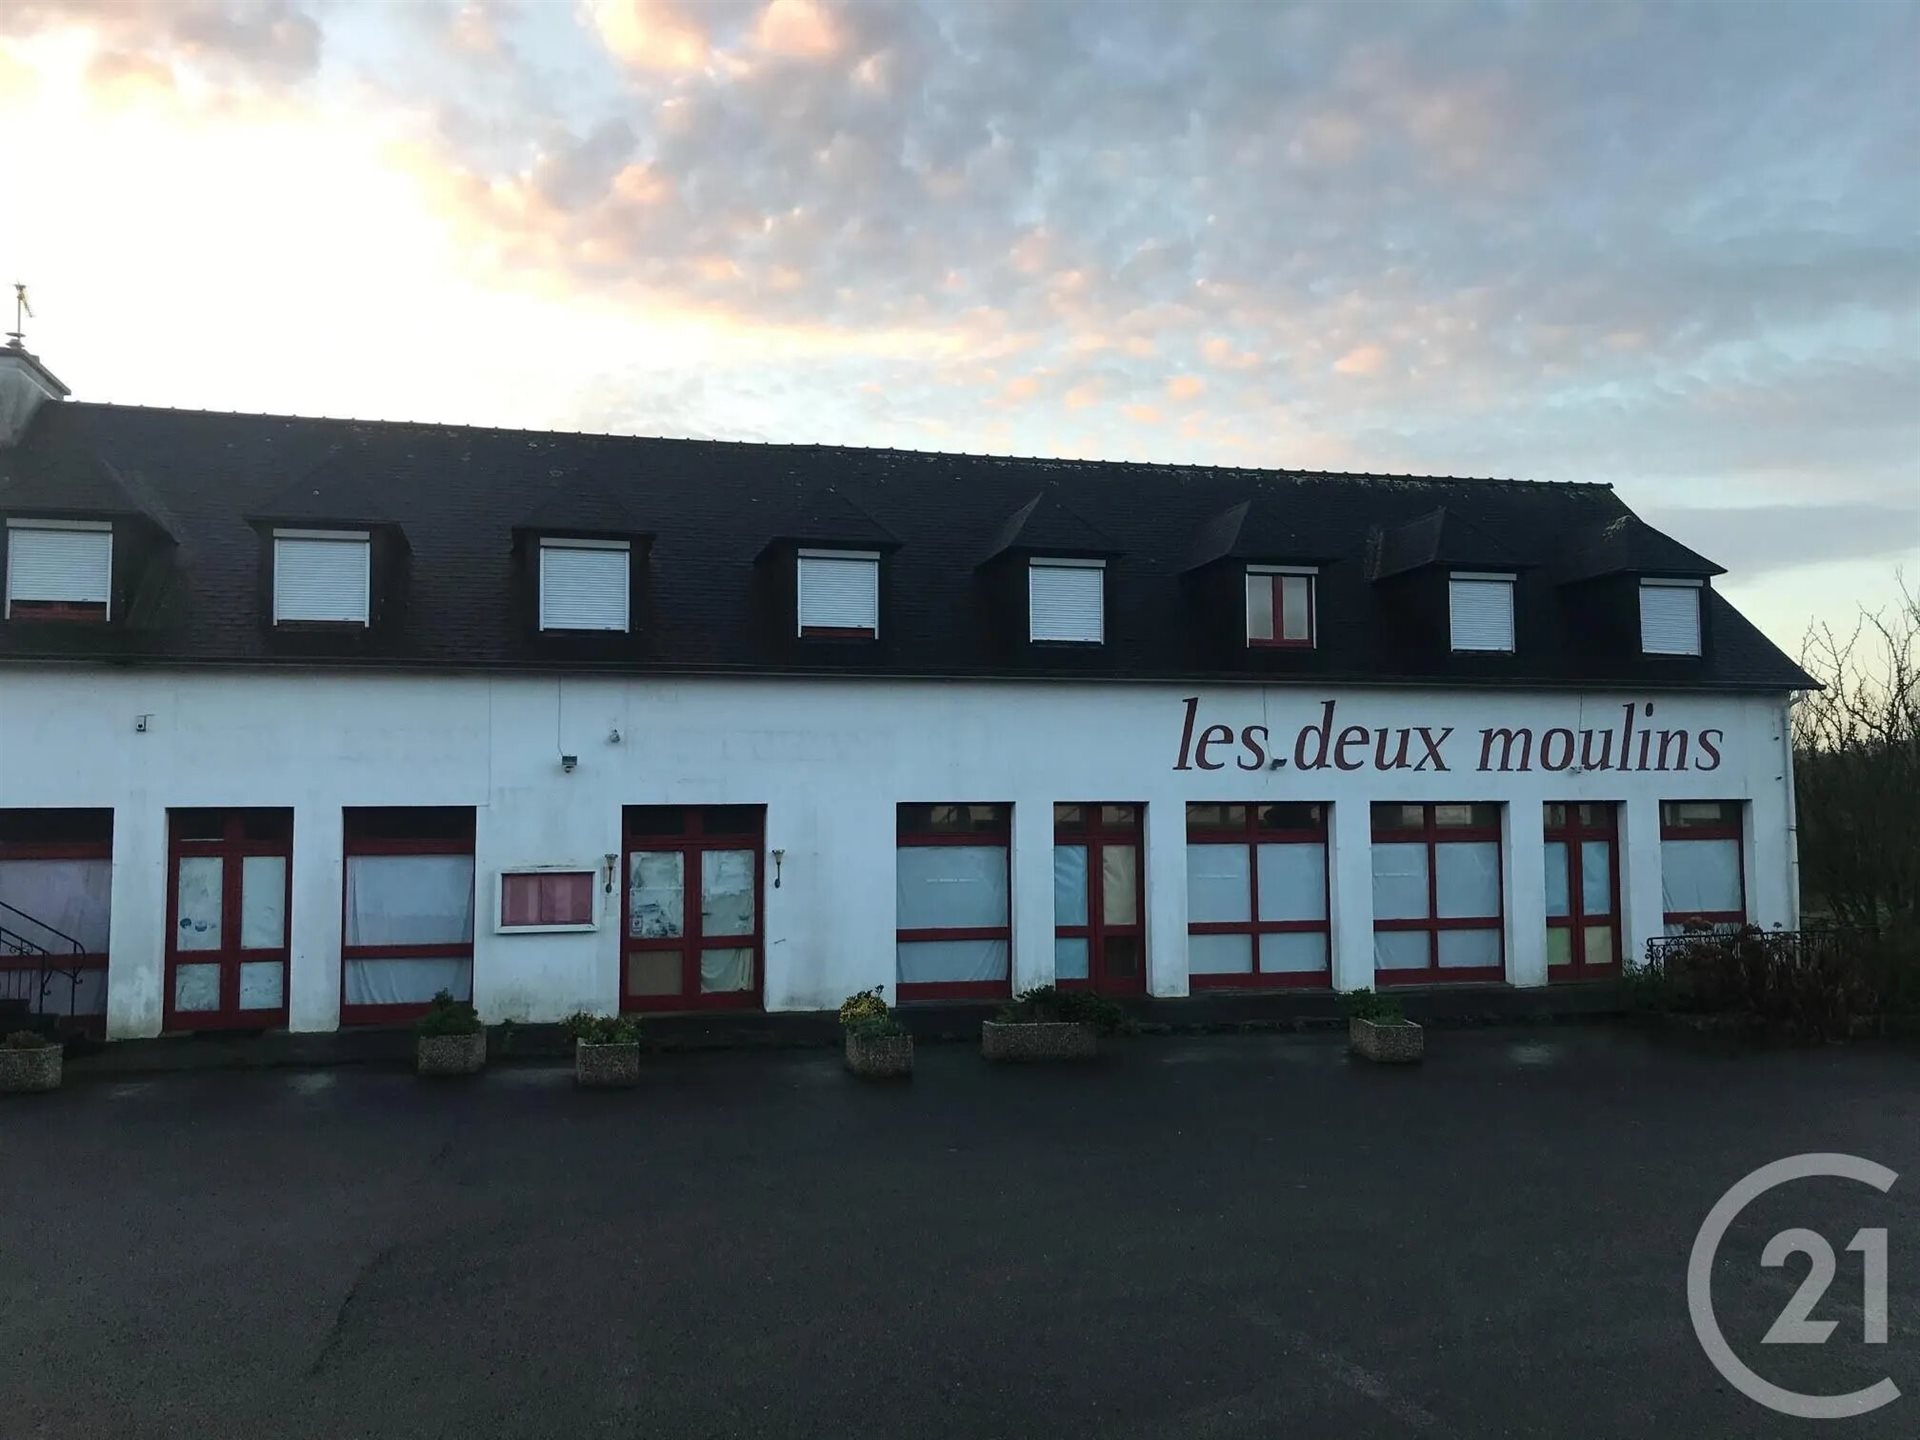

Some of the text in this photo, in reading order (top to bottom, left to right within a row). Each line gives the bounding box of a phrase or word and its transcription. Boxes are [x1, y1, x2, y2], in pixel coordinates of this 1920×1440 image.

[1172, 697, 1724, 772] les deux moulins
